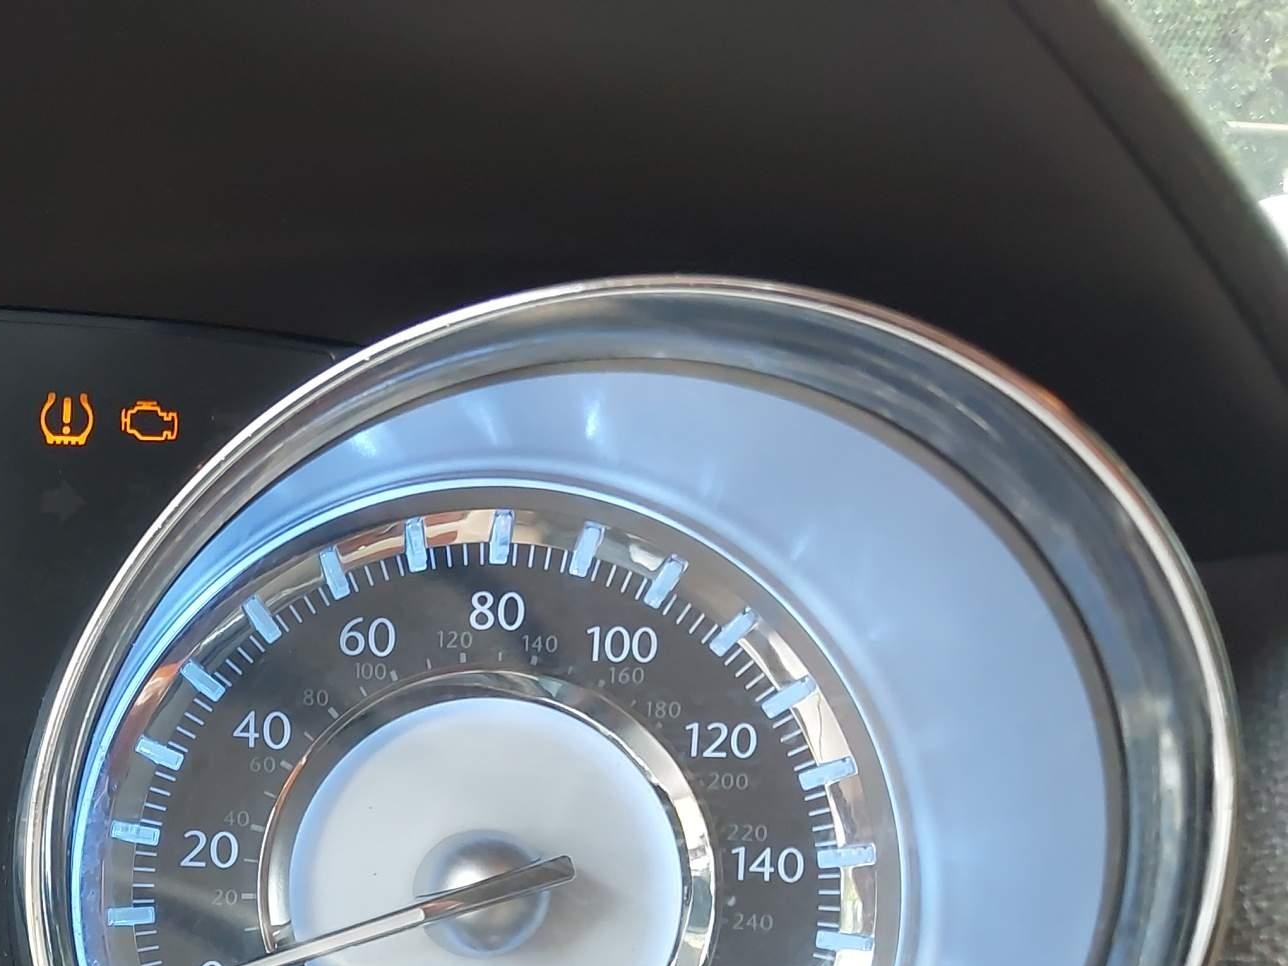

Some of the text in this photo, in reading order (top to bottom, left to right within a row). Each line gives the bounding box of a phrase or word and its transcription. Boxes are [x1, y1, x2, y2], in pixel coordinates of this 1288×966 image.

[469, 591, 525, 631] 80
[339, 617, 396, 657] 60
[437, 630, 473, 649] 120
[522, 634, 558, 653] 140
[586, 625, 658, 663] 100
[355, 662, 387, 680] 100
[609, 666, 644, 685] 160
[303, 689, 329, 706] 80
[647, 700, 681, 719] 180
[232, 710, 291, 750] 40
[685, 721, 758, 760] 120
[249, 756, 276, 773] 60
[708, 772, 749, 791] 200
[223, 810, 250, 827] 40
[727, 824, 768, 842] 220
[180, 829, 239, 869] 20
[731, 845, 804, 884] 140
[211, 889, 237, 906] 20
[732, 913, 774, 932] 240
